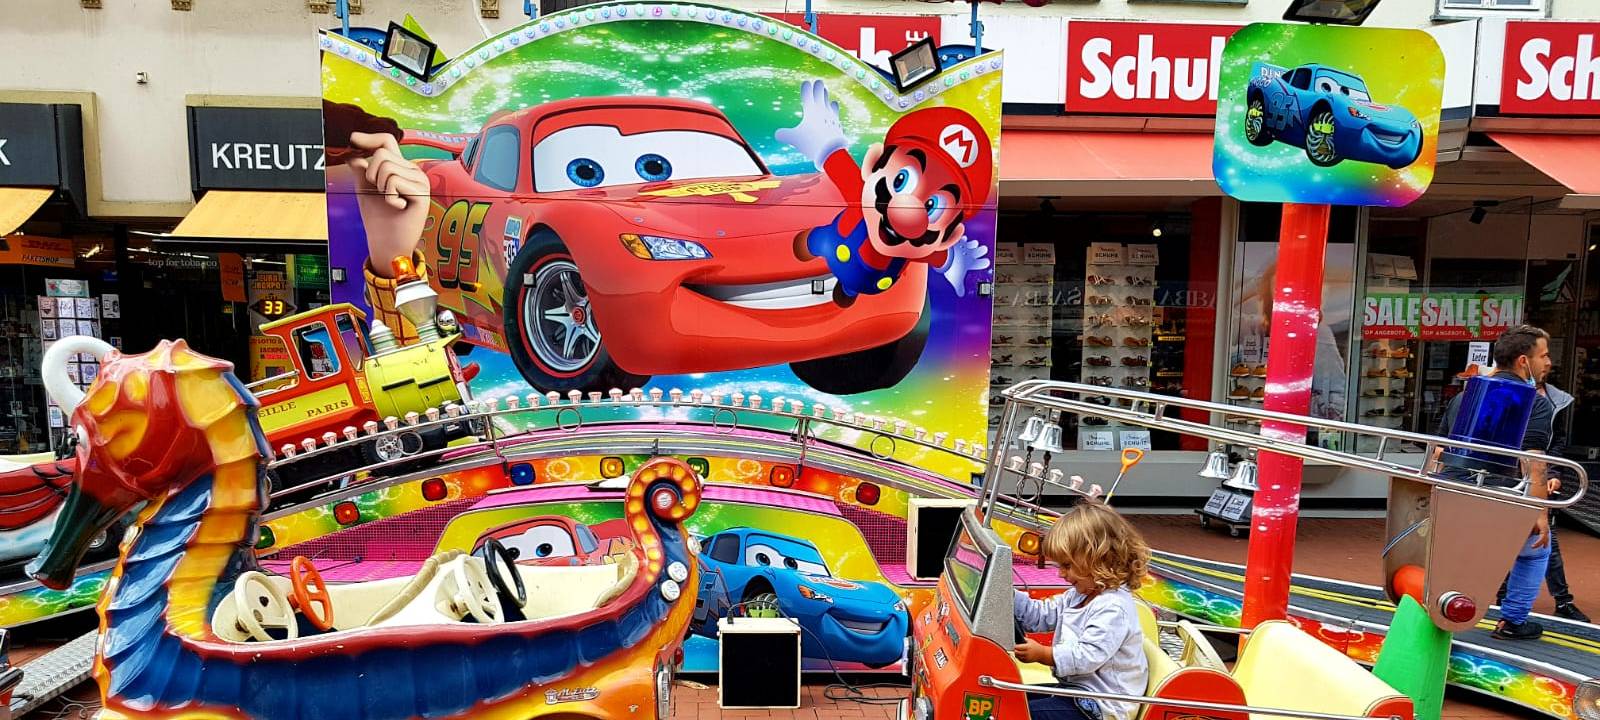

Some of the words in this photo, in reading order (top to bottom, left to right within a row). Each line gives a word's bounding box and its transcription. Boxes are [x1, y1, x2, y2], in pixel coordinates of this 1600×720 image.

[1516, 34, 1600, 101] Sch
[943, 129, 973, 163] M
[437, 199, 493, 293] 95
[264, 300, 284, 315] 33
[1364, 296, 1420, 326] SALE
[1422, 297, 1481, 327] SALE
[306, 399, 349, 418] PARIS
[969, 699, 992, 716] BP
